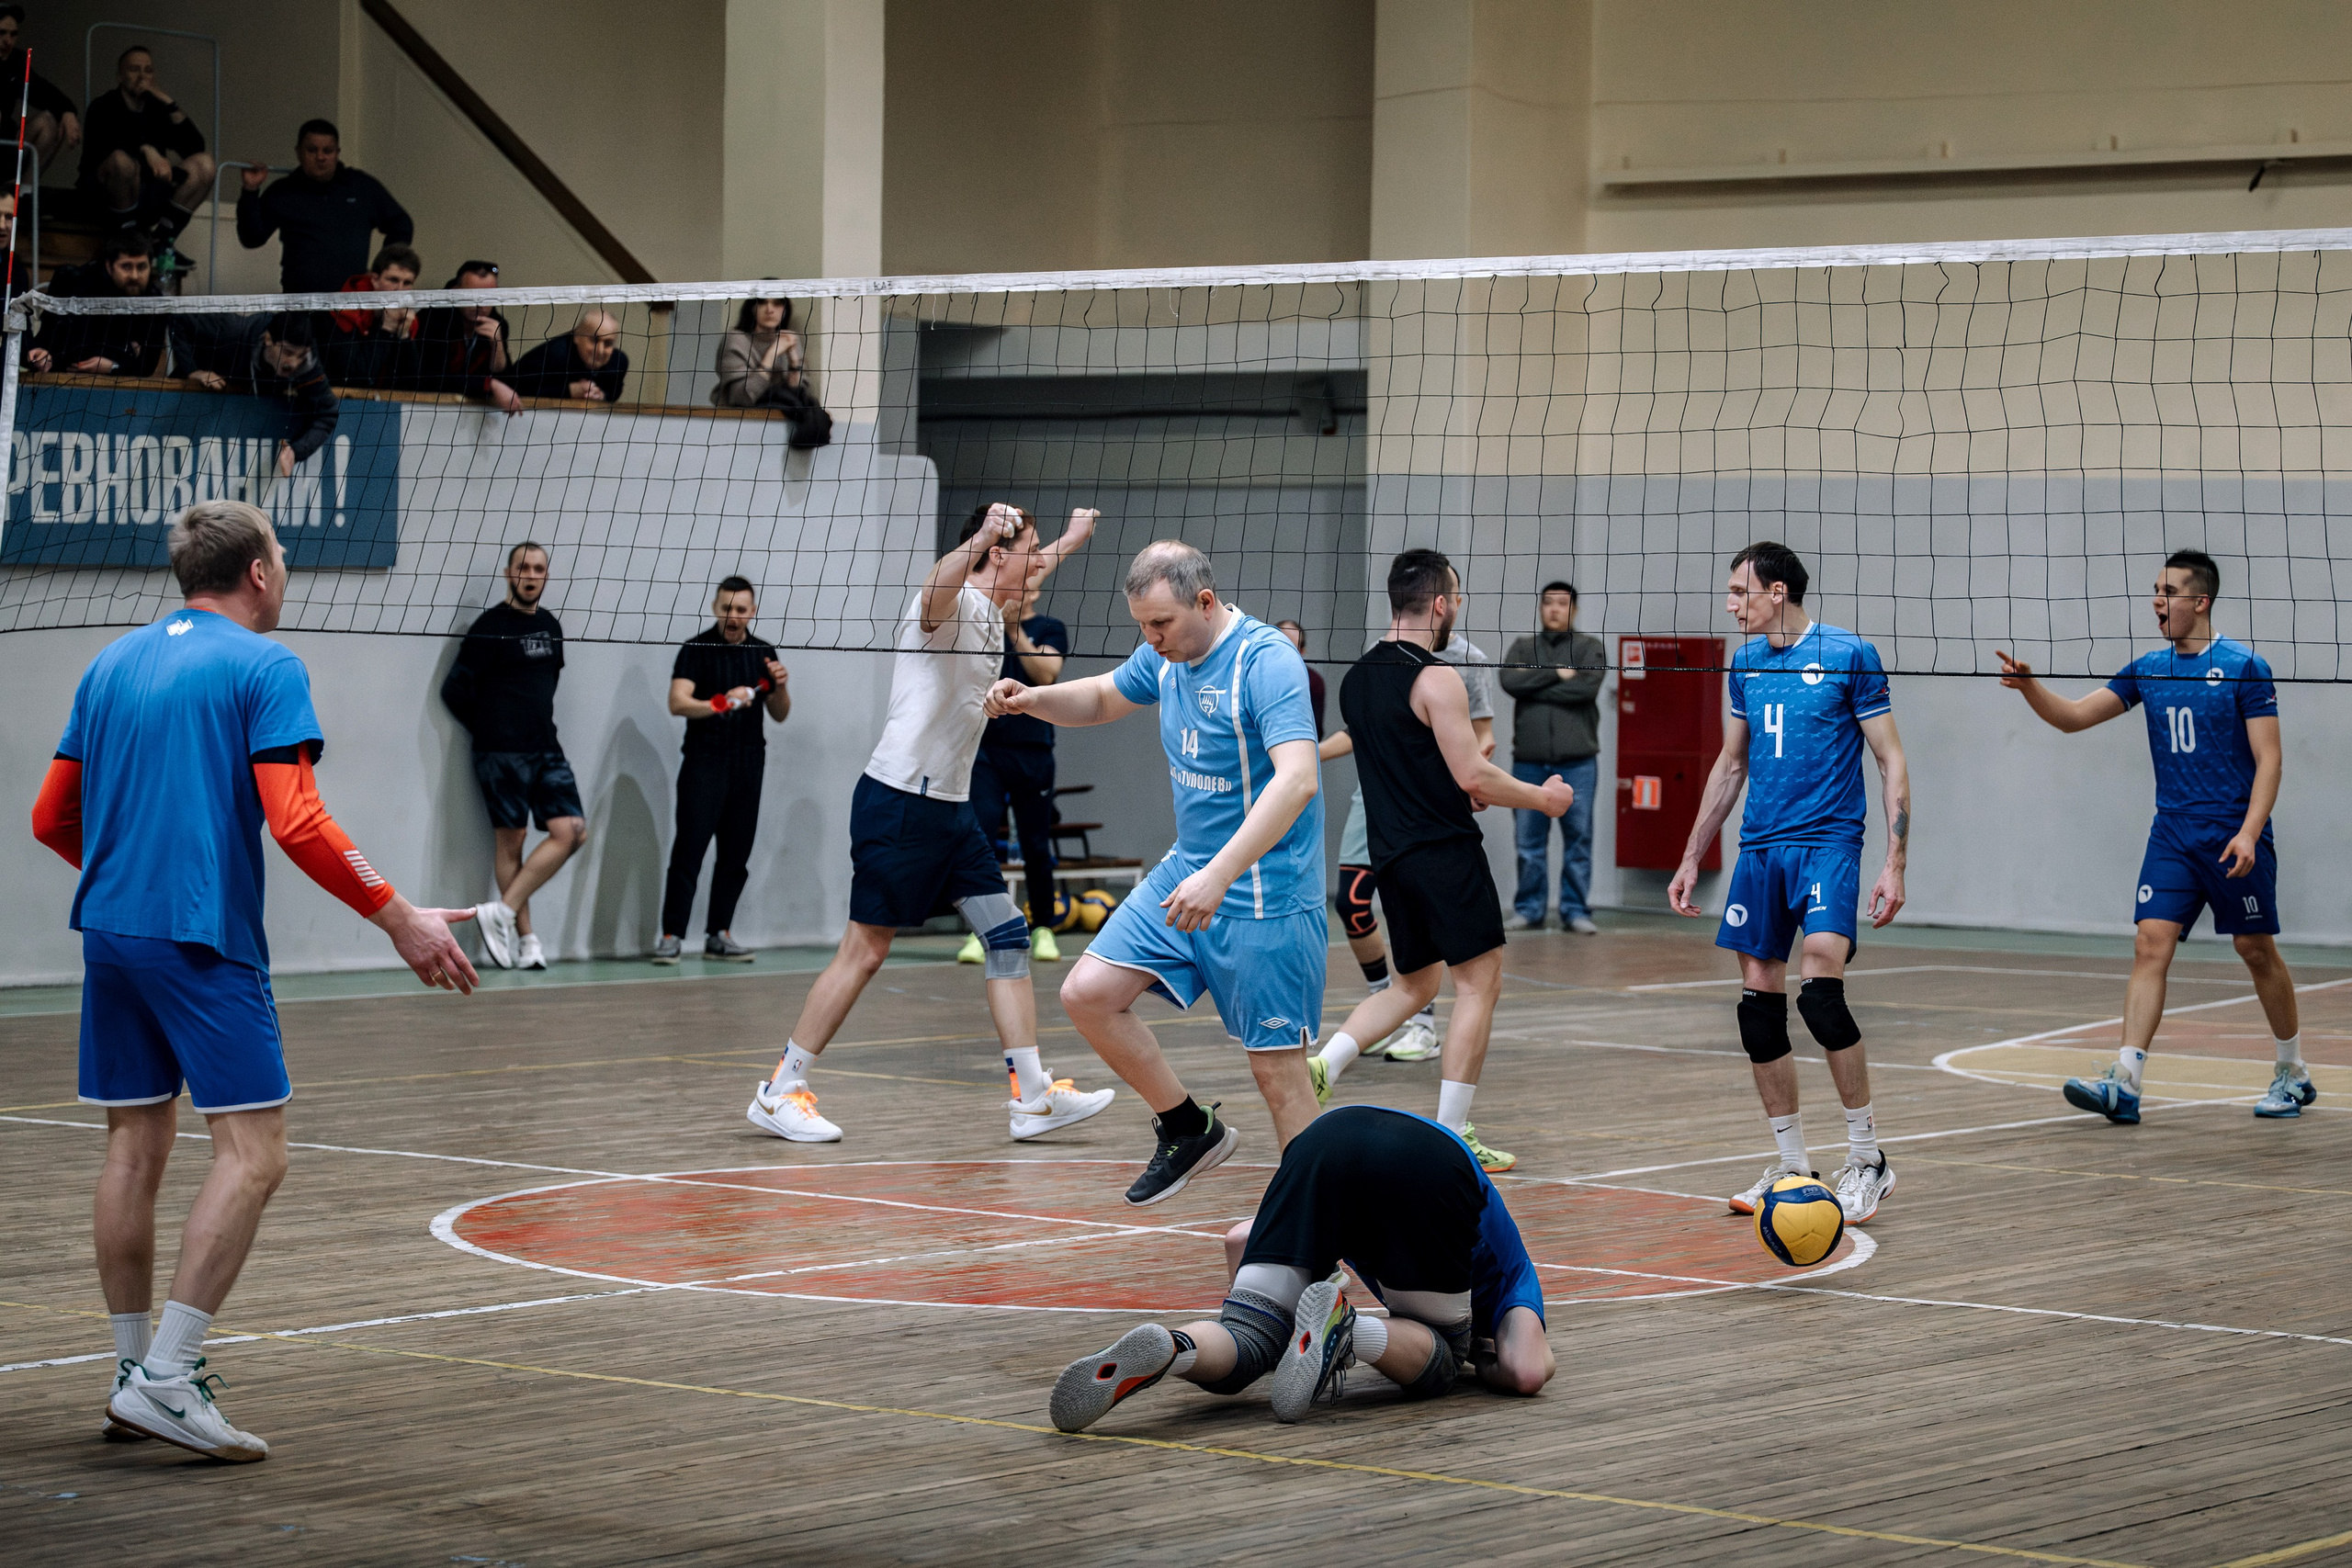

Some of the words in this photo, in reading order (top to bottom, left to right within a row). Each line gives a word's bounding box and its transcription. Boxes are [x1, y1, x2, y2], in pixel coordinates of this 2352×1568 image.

[1180, 727, 1198, 759] 14
[1764, 704, 1784, 758] 4
[2165, 706, 2196, 753] 10
[1811, 882, 1821, 904] 4
[2242, 896, 2258, 913] 10
